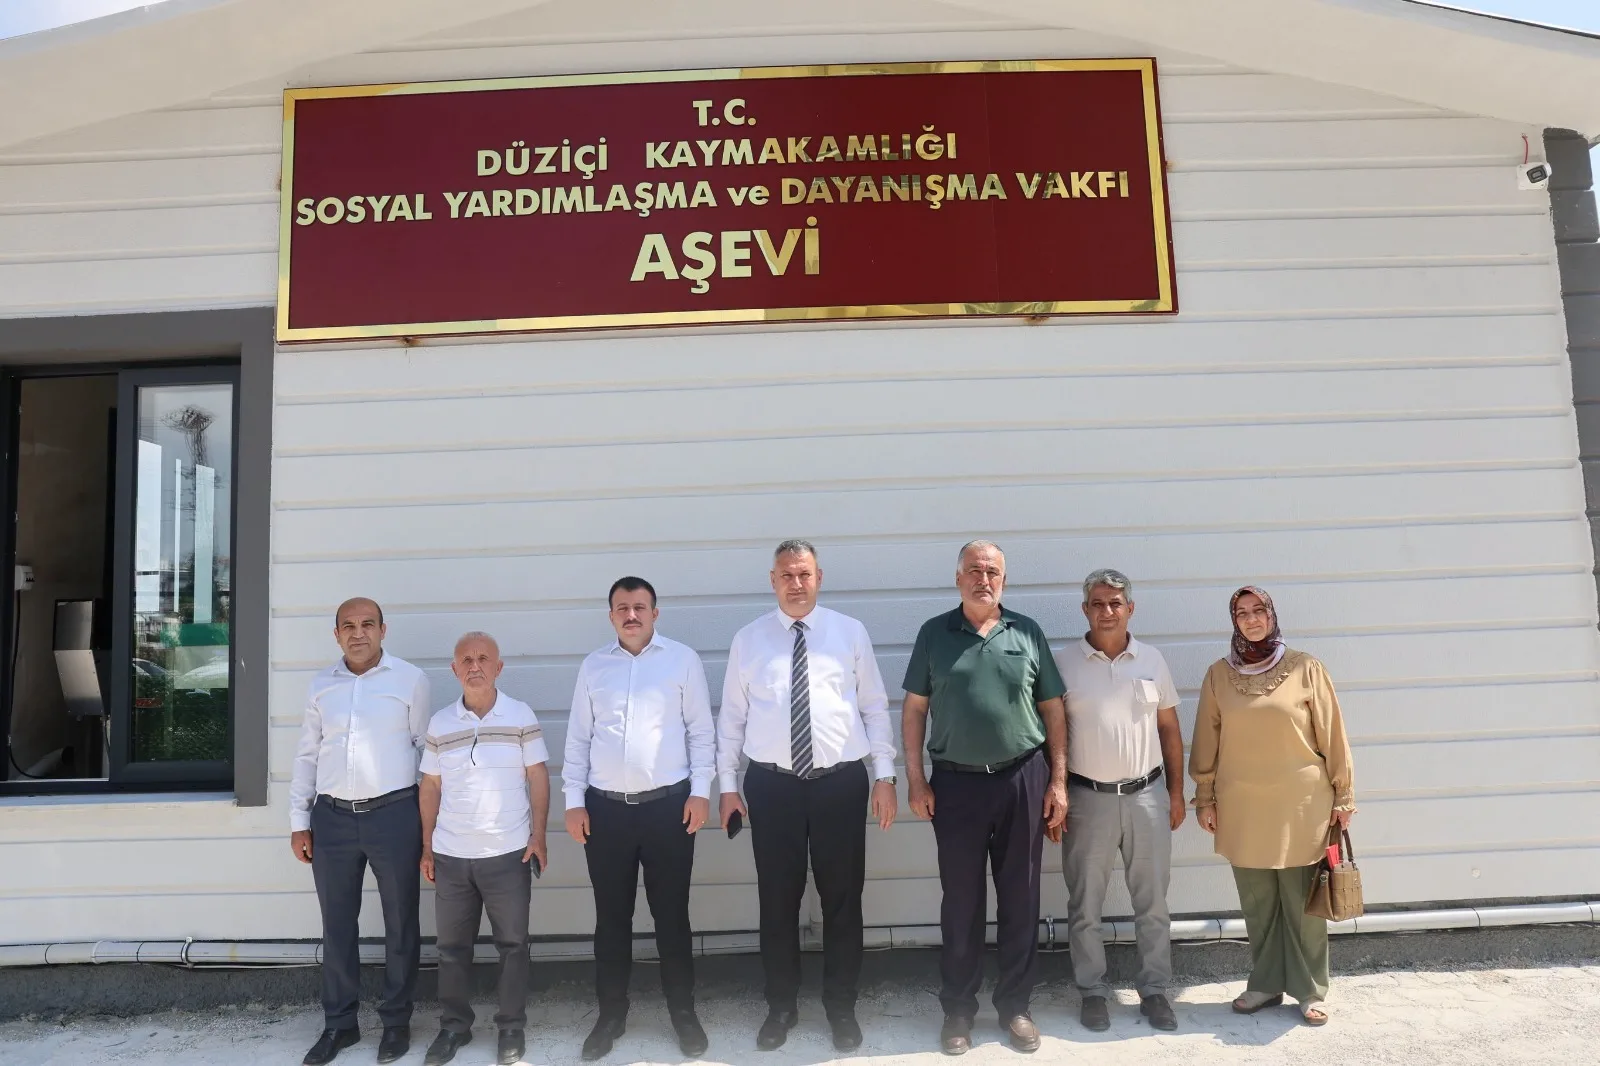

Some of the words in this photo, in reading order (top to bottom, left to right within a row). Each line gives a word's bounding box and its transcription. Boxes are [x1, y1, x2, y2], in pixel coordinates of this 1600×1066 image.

[693, 99, 756, 126] T.C.
[478, 137, 607, 179] DÜZİÇİ
[646, 124, 956, 168] KAYMAKAMLIĞI
[296, 194, 432, 226] SOSYAL
[443, 181, 717, 218] YARDIMLAŞMA
[727, 186, 769, 206] ve
[782, 174, 1007, 209] DAYANIŞMA
[1015, 171, 1129, 199] VAKFI
[630, 216, 819, 294] AŞEVİ
